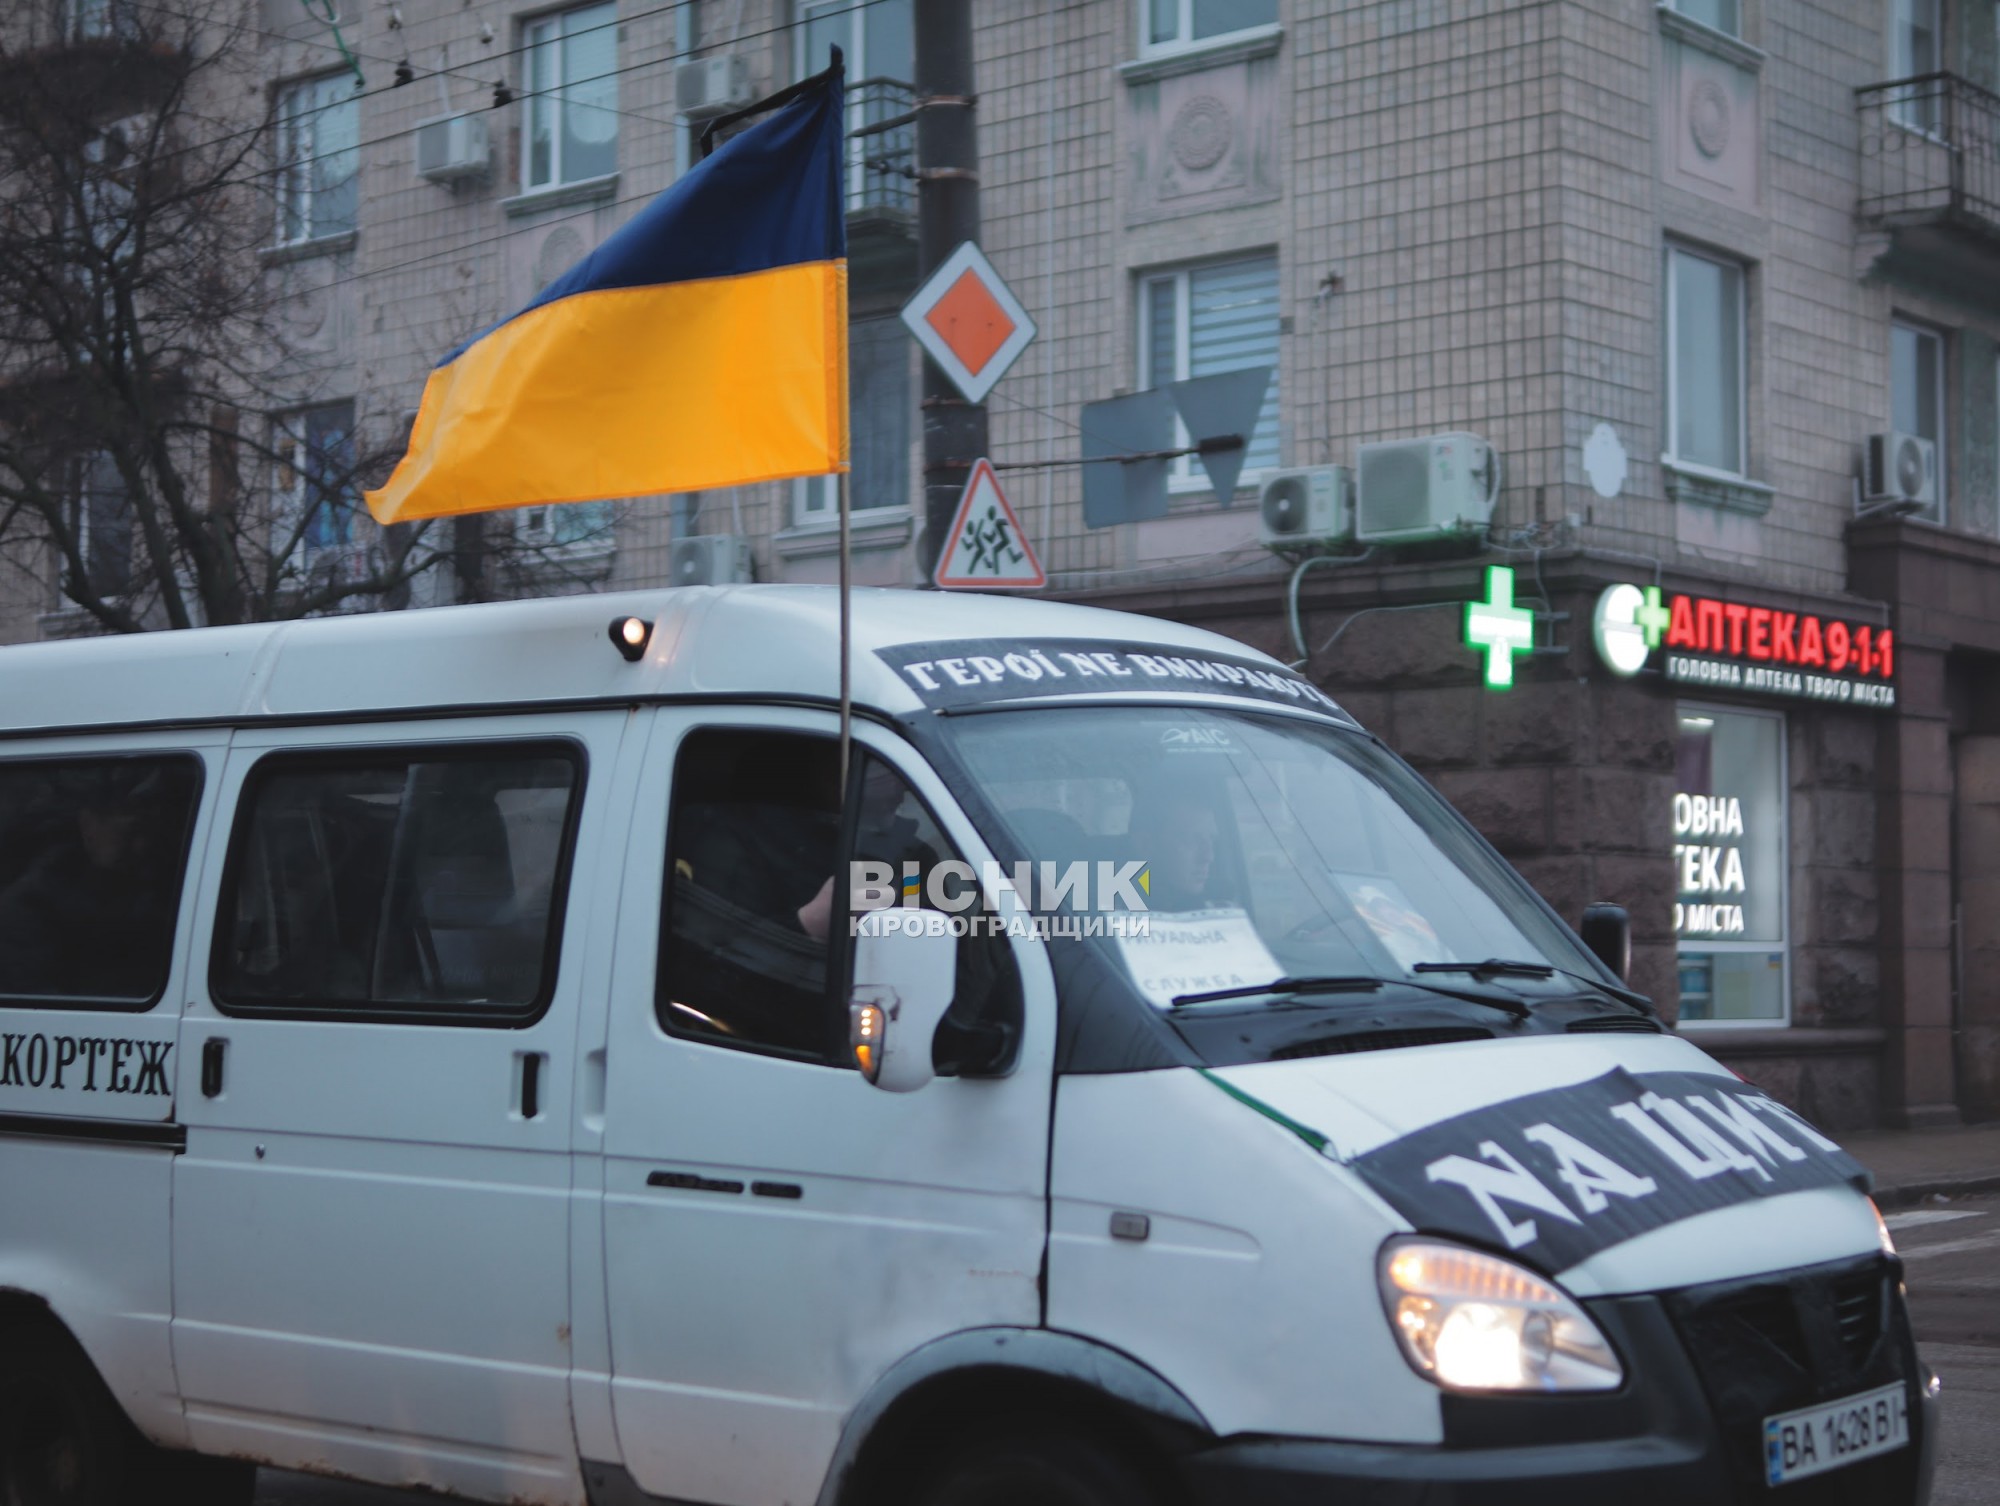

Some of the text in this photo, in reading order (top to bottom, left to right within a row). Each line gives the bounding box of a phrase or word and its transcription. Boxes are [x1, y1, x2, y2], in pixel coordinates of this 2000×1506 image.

[1667, 594, 1824, 667] АПТЕКА
[903, 649, 1066, 690] ГЕРОЇ
[1669, 656, 1895, 706] ГОЛОВНА АПТЕКА ТВОГО МІСТА
[1689, 903, 1745, 932] МІСТА
[0, 1033, 174, 1097] КОРТЕЖ
[1822, 1405, 1871, 1458] 1628
